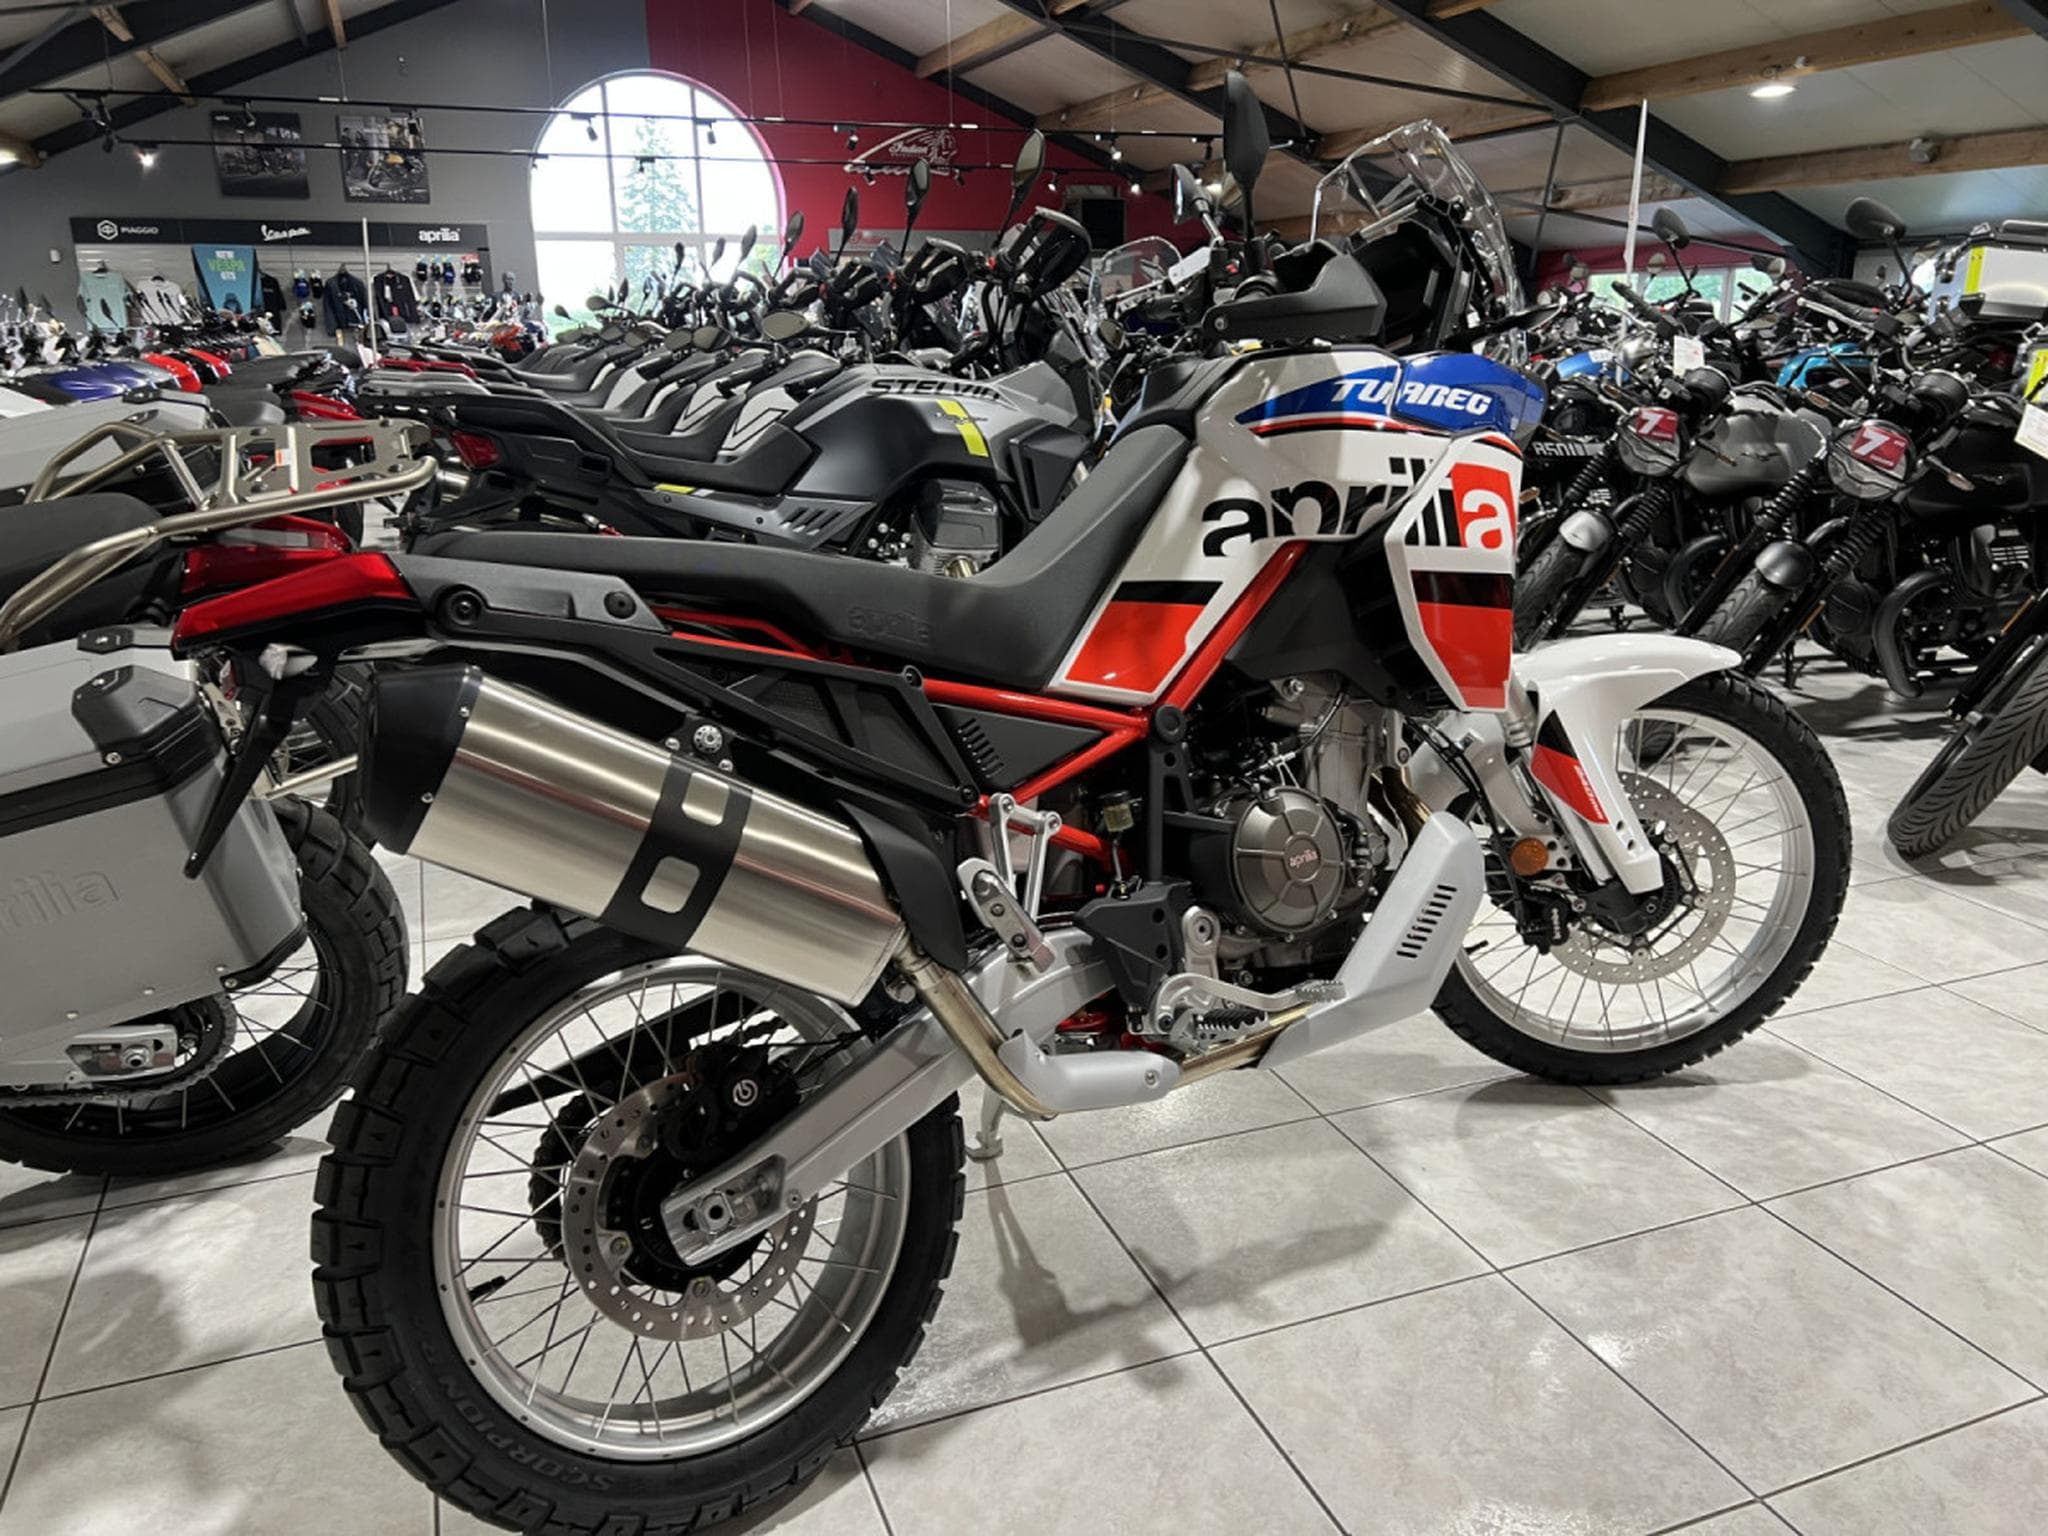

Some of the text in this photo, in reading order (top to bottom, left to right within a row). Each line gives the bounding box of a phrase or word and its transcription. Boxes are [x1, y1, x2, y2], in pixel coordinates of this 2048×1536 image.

[121, 226, 159, 234] PIAGGIO
[261, 225, 311, 241] Vespa
[418, 228, 461, 243] aprilia
[1331, 378, 1493, 416] TUAREG
[1638, 410, 1665, 434] 7
[1854, 427, 1890, 456] 7
[1201, 456, 1514, 558] aprilia
[1289, 849, 1319, 869] aprilia
